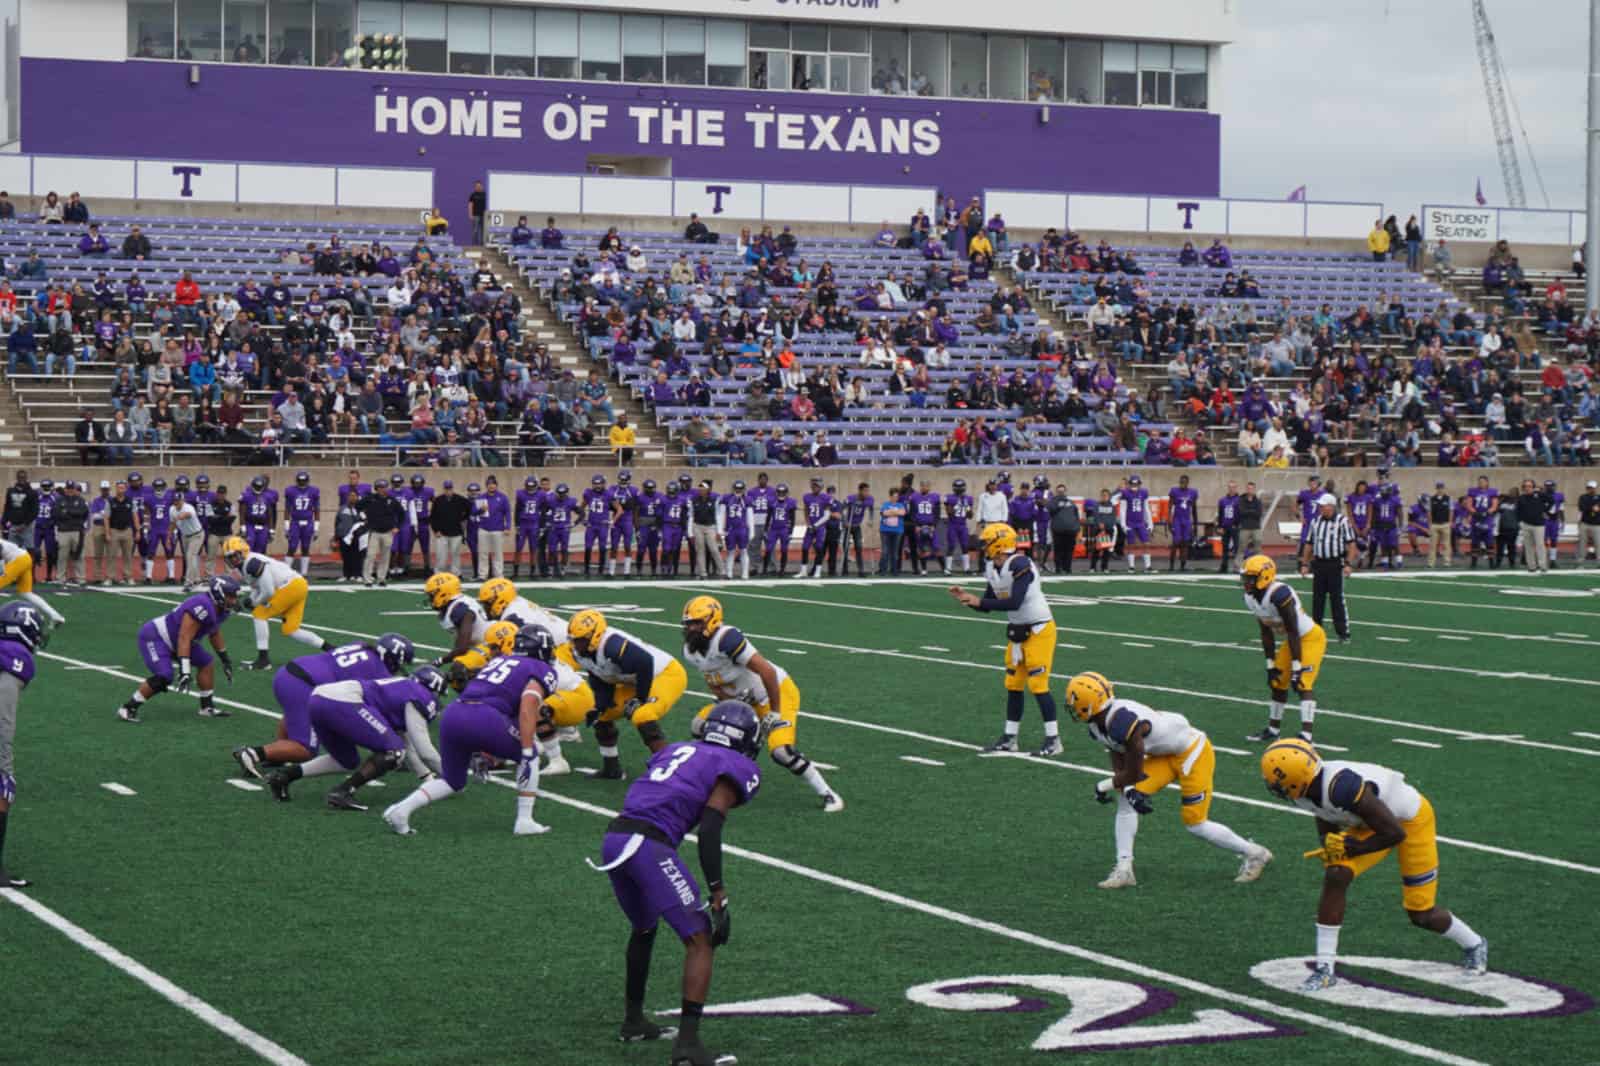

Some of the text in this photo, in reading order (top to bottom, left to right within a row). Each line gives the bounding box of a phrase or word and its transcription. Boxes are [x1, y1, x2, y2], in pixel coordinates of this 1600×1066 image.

[375, 95, 941, 156] HOME OF THE TEXANS
[172, 166, 202, 197] T
[705, 185, 732, 214] T
[1177, 202, 1200, 230] T
[1432, 211, 1491, 225] STUDENT
[1435, 225, 1487, 238] SEATING
[476, 657, 520, 685] 25
[649, 745, 697, 782] 3
[746, 773, 760, 793] 3
[659, 857, 695, 906] TEXANS
